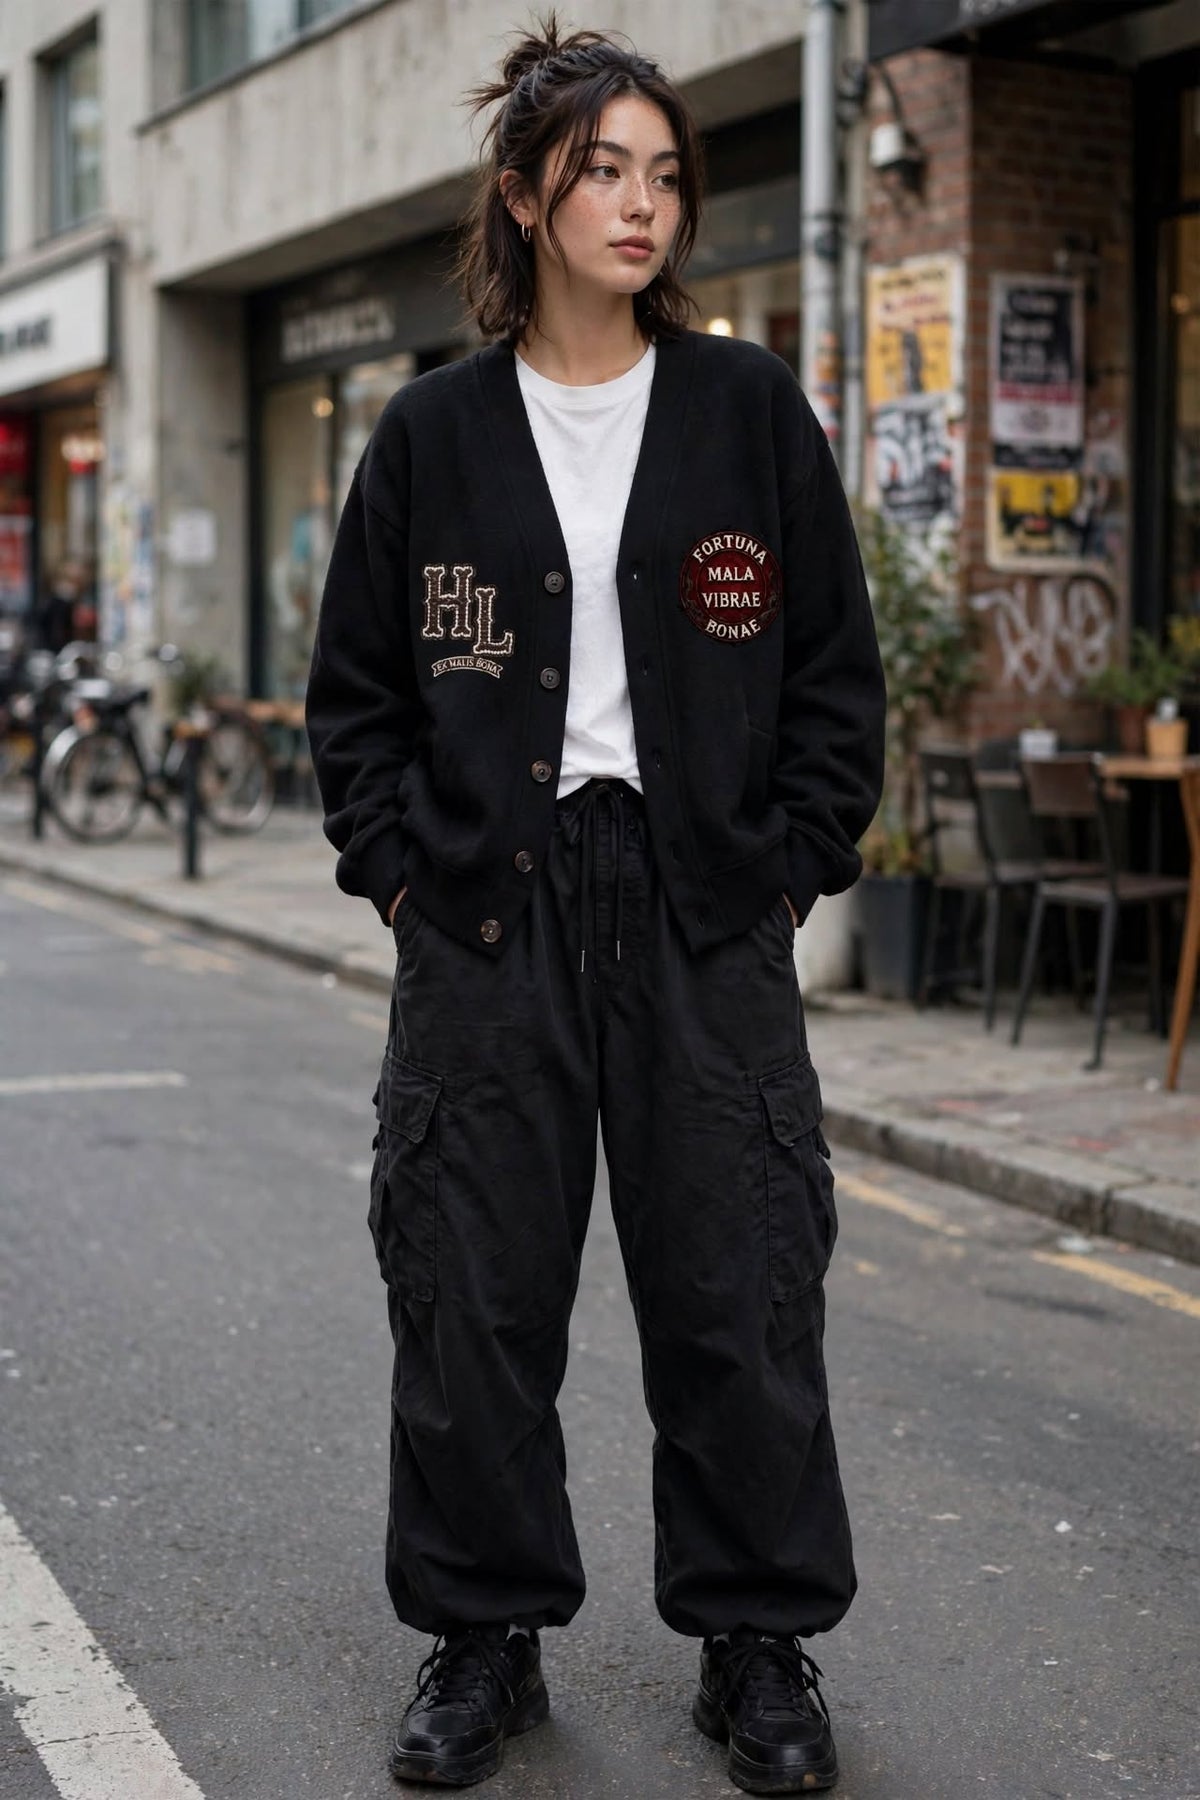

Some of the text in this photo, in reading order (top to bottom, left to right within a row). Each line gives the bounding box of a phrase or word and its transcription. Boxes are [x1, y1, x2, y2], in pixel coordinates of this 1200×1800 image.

[692, 534, 767, 565] FORTUNA
[707, 566, 755, 581] MALA
[702, 592, 761, 608] VIBRAE
[705, 619, 761, 639] BONAE
[449, 658, 474, 667] MALIS
[475, 659, 498, 674] BONA
